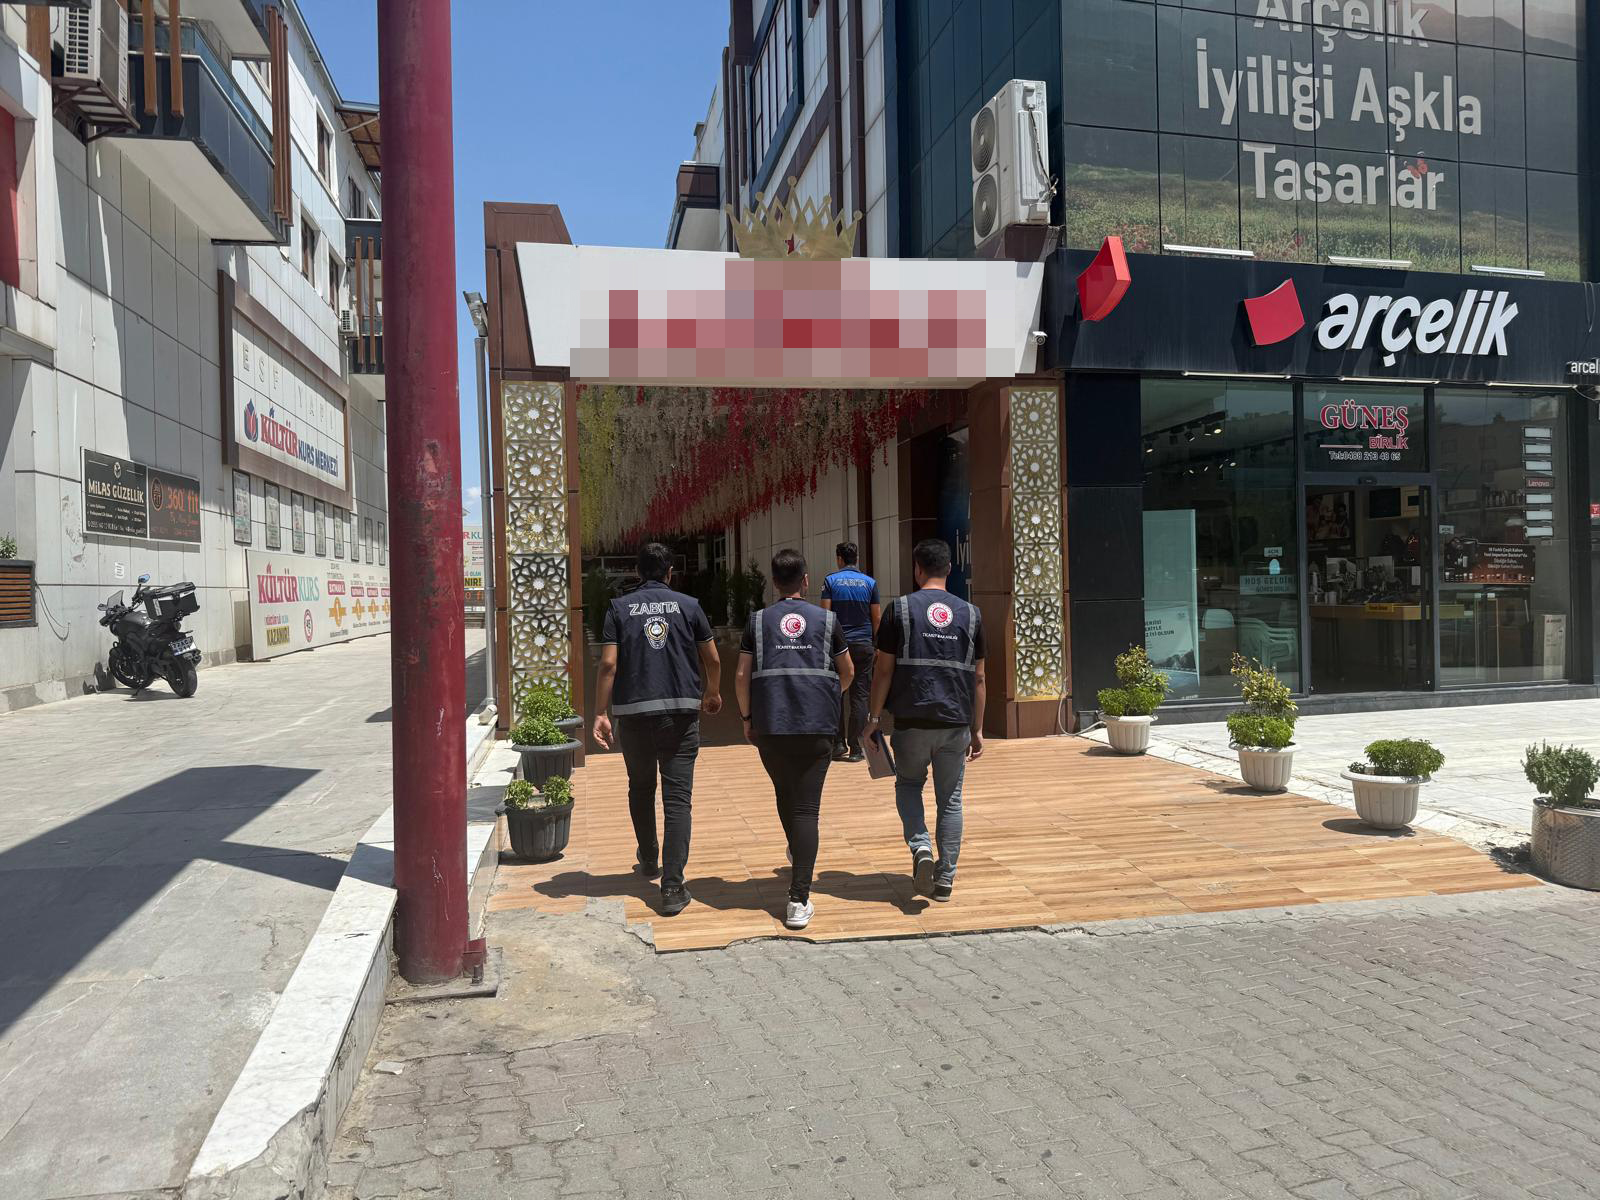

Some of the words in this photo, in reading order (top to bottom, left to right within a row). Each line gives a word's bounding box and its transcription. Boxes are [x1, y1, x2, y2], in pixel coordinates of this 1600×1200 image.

[1196, 37, 1335, 132] İyiliği
[1350, 67, 1482, 143] Aşkla
[1242, 141, 1444, 211] Tasarlar
[1317, 288, 1519, 368] arçelik
[1319, 398, 1409, 437] GÜNEŞ
[298, 440, 315, 466] KURS
[1363, 451, 1378, 461] 213
[1368, 434, 1409, 449] BİRLİK
[257, 562, 299, 604] KÜLTÜR
[298, 575, 320, 602] KURS
[629, 601, 681, 616] ZABITA
